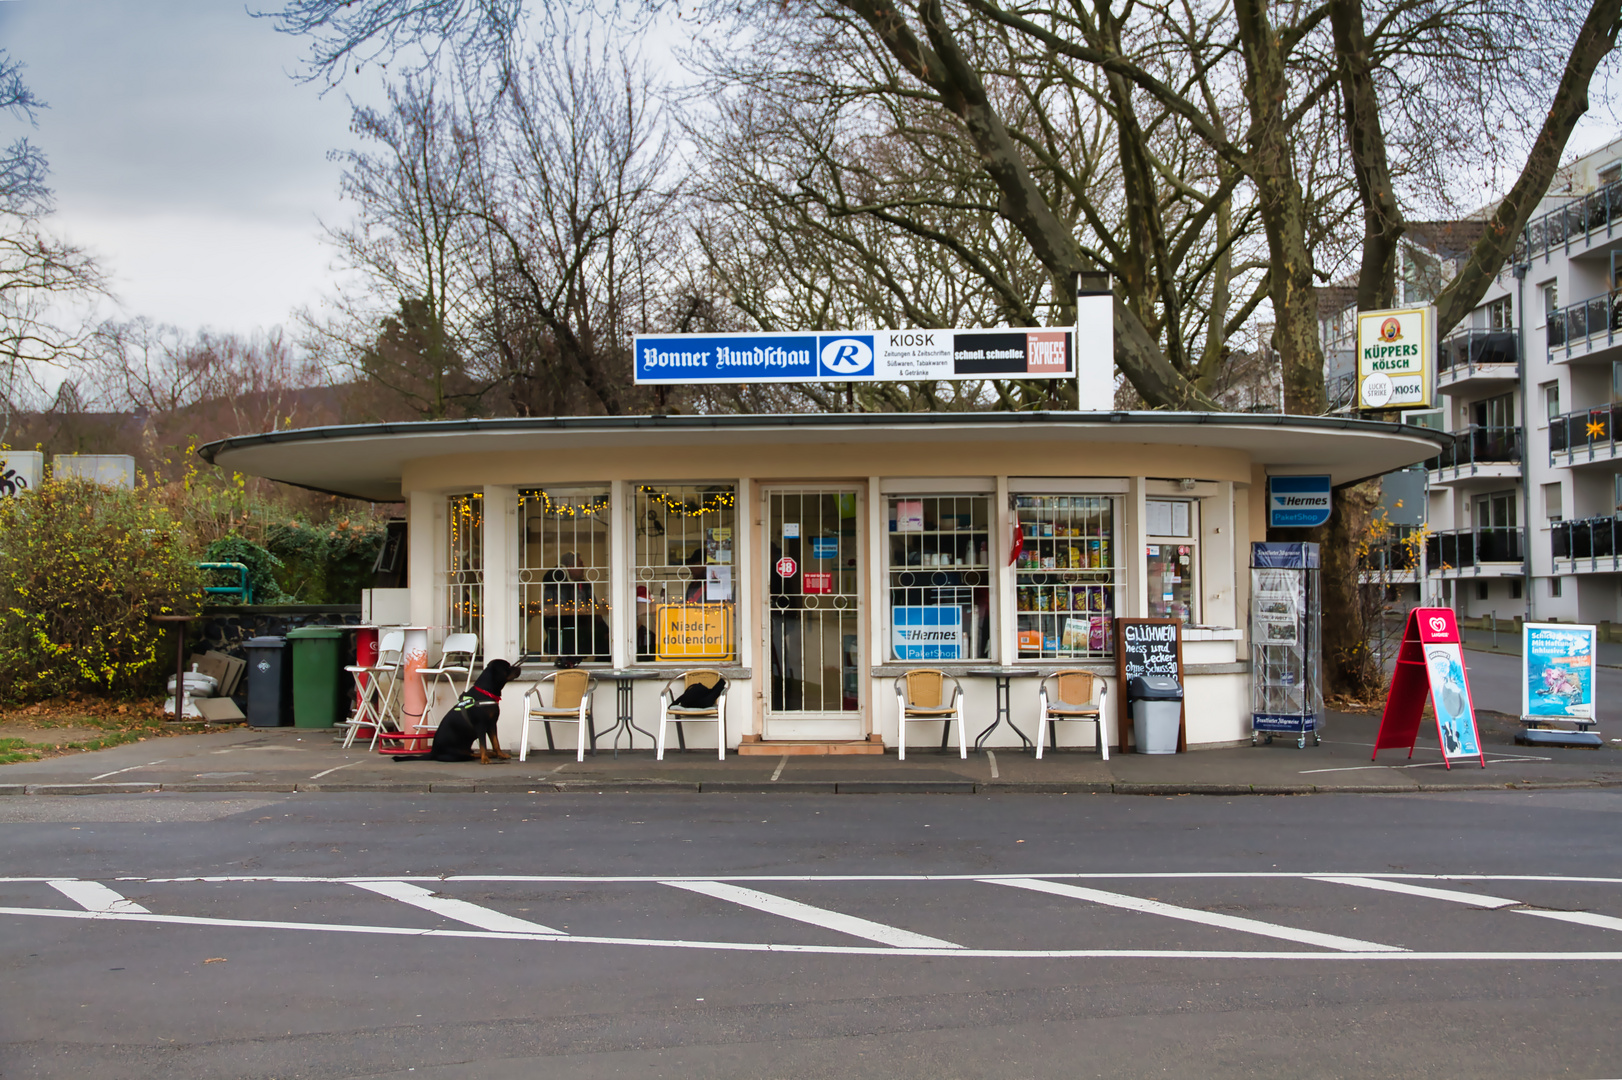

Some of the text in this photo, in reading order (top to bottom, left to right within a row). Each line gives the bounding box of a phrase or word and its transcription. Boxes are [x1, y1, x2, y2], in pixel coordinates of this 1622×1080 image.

[890, 333, 934, 346] KIOSK
[884, 350, 910, 358] Zeitungen
[918, 349, 950, 357] Zeitschriften
[954, 348, 1024, 360] schnell. schneller.
[1029, 341, 1065, 365] EXPRESS
[1364, 343, 1418, 359] KÜPPERS
[643, 347, 711, 371] Bonner
[1372, 358, 1409, 370] KÖLSCH
[1287, 496, 1328, 506] Hermes
[1275, 513, 1318, 522] PaketShop
[671, 621, 716, 632] Nieder-
[663, 635, 724, 645] dollendorf
[911, 629, 957, 641] Hermes
[1150, 641, 1170, 652] und
[908, 649, 957, 659] PaketShop
[1125, 661, 1144, 672] ohne
